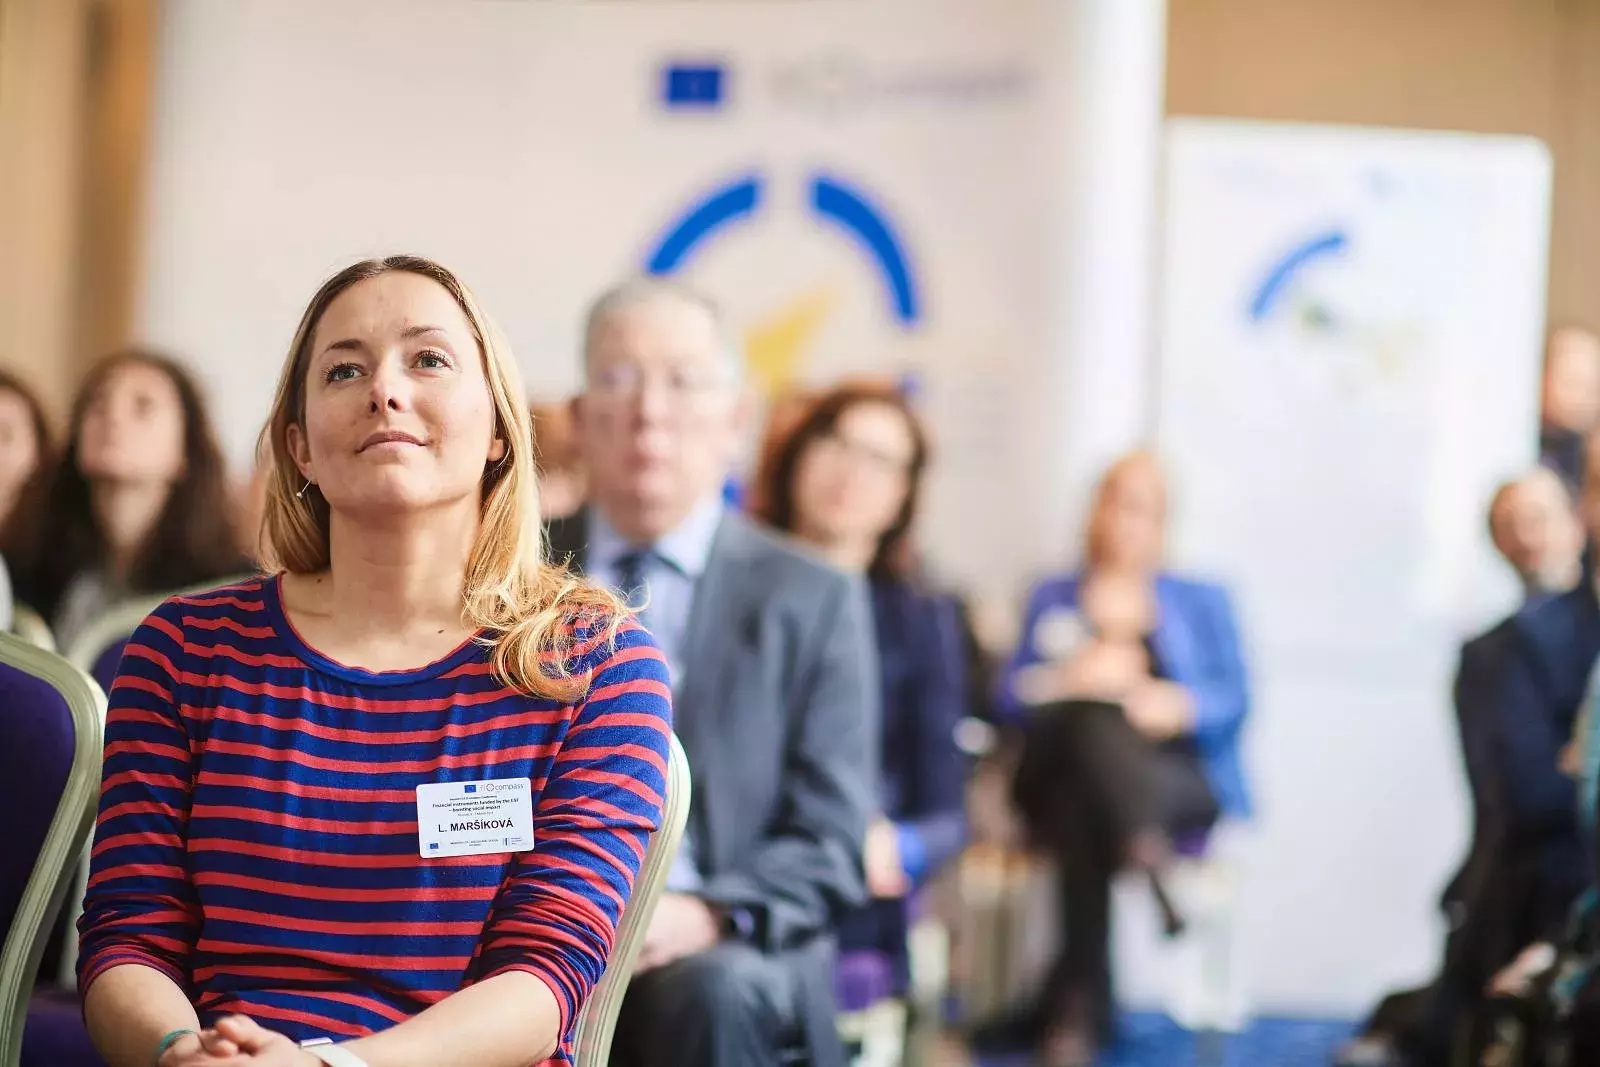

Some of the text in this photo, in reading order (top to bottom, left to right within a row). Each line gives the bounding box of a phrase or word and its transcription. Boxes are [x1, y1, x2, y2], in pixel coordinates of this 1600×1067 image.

[495, 783, 525, 791] compass
[438, 817, 514, 833] L. MARŠÍKOVÁ
